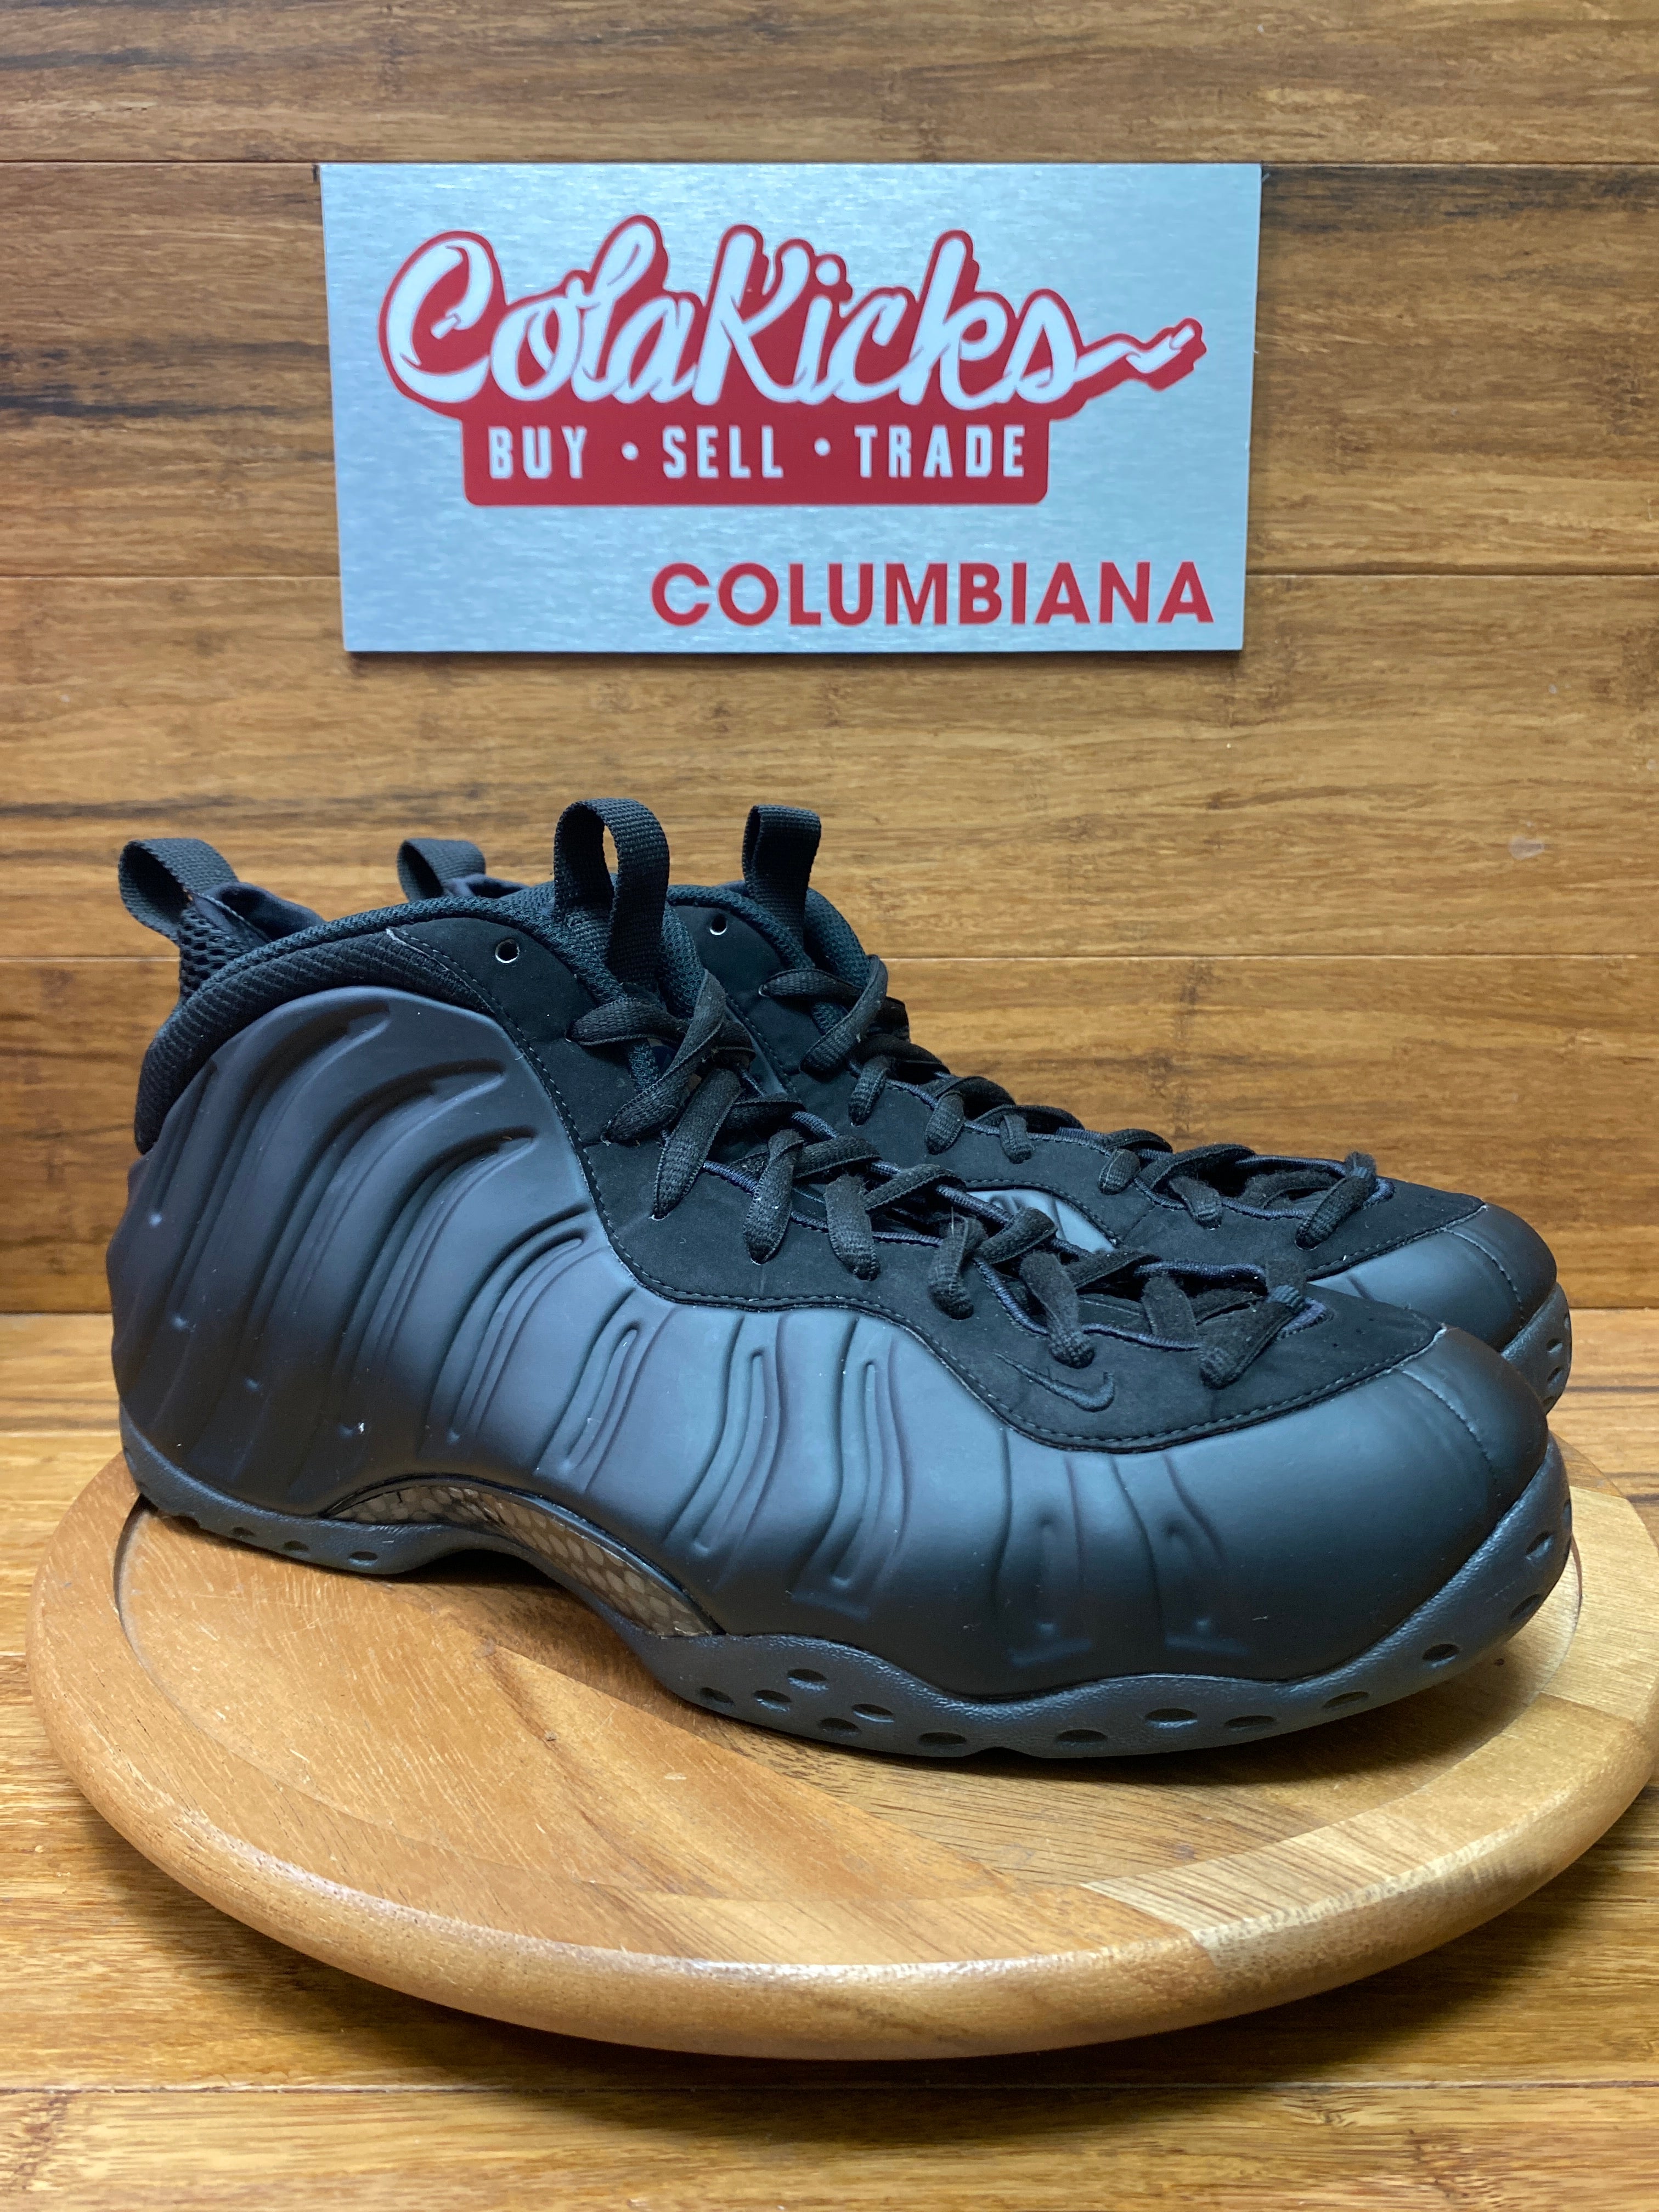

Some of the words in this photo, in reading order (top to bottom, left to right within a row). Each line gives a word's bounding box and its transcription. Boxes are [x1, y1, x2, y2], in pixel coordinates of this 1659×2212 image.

[383, 217, 1199, 410] ColaKicks
[488, 425, 588, 480] BUY
[662, 425, 783, 479] SELL
[854, 424, 1026, 479] TRADE
[650, 561, 1215, 627] COLUMBIANA
